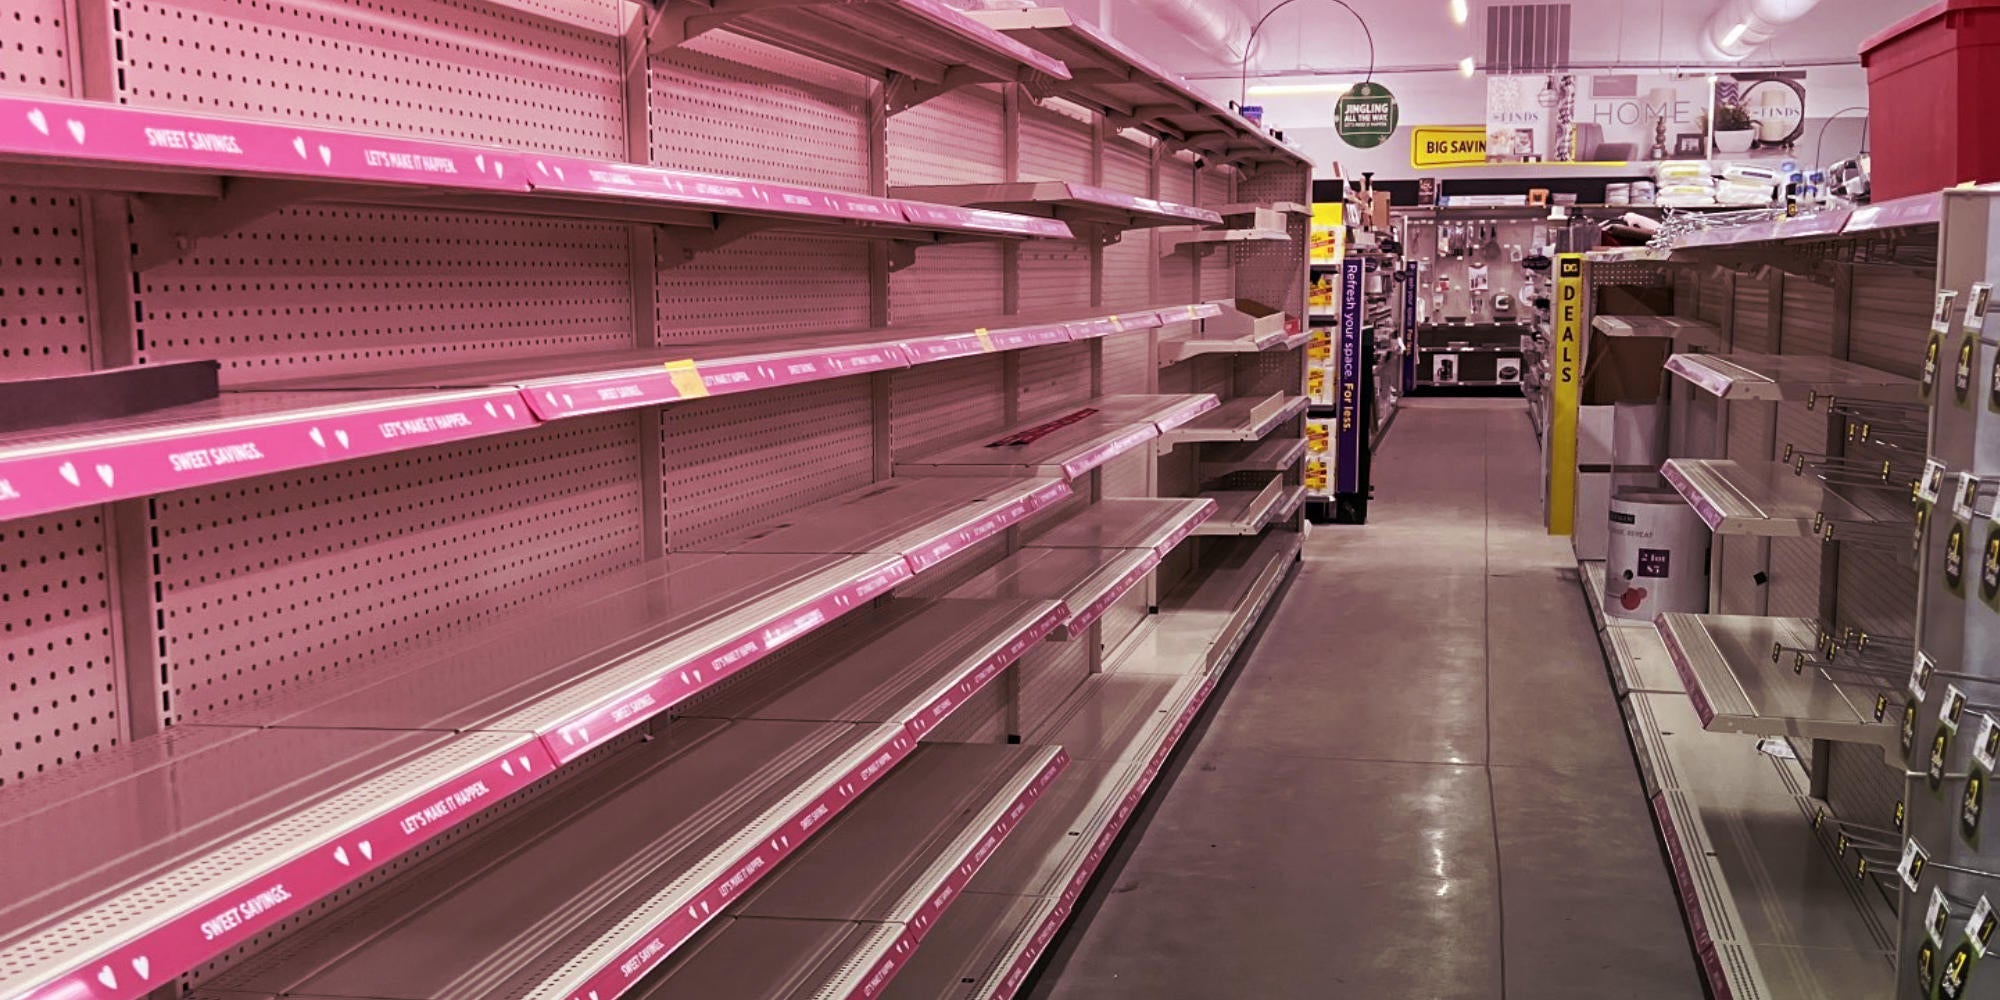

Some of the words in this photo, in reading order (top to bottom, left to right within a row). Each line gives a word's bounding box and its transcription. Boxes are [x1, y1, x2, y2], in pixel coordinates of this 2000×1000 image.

[1344, 103, 1389, 114] JINGLING
[1344, 114, 1357, 122] ALL
[1358, 113, 1371, 122] THE
[1501, 111, 1539, 122] FINDS
[1592, 100, 1692, 126] HOME
[144, 127, 189, 149] SWEET
[1427, 141, 1448, 154] BIG
[364, 149, 391, 168] LET'S
[388, 152, 415, 170] MAKE
[412, 154, 424, 171] IT
[1563, 263, 1578, 272] DG
[1346, 264, 1358, 312] Refresh
[1342, 312, 1355, 341] your
[1561, 285, 1576, 383] DEALS
[1343, 383, 1355, 404] For
[378, 421, 407, 439] LET'S
[402, 418, 430, 434] MAKE
[424, 416, 438, 432] IT
[168, 450, 213, 472] SWEET
[400, 811, 428, 836] LET'S
[422, 800, 450, 824] MAKE
[444, 795, 457, 813] IT
[201, 906, 243, 941] SWEET
